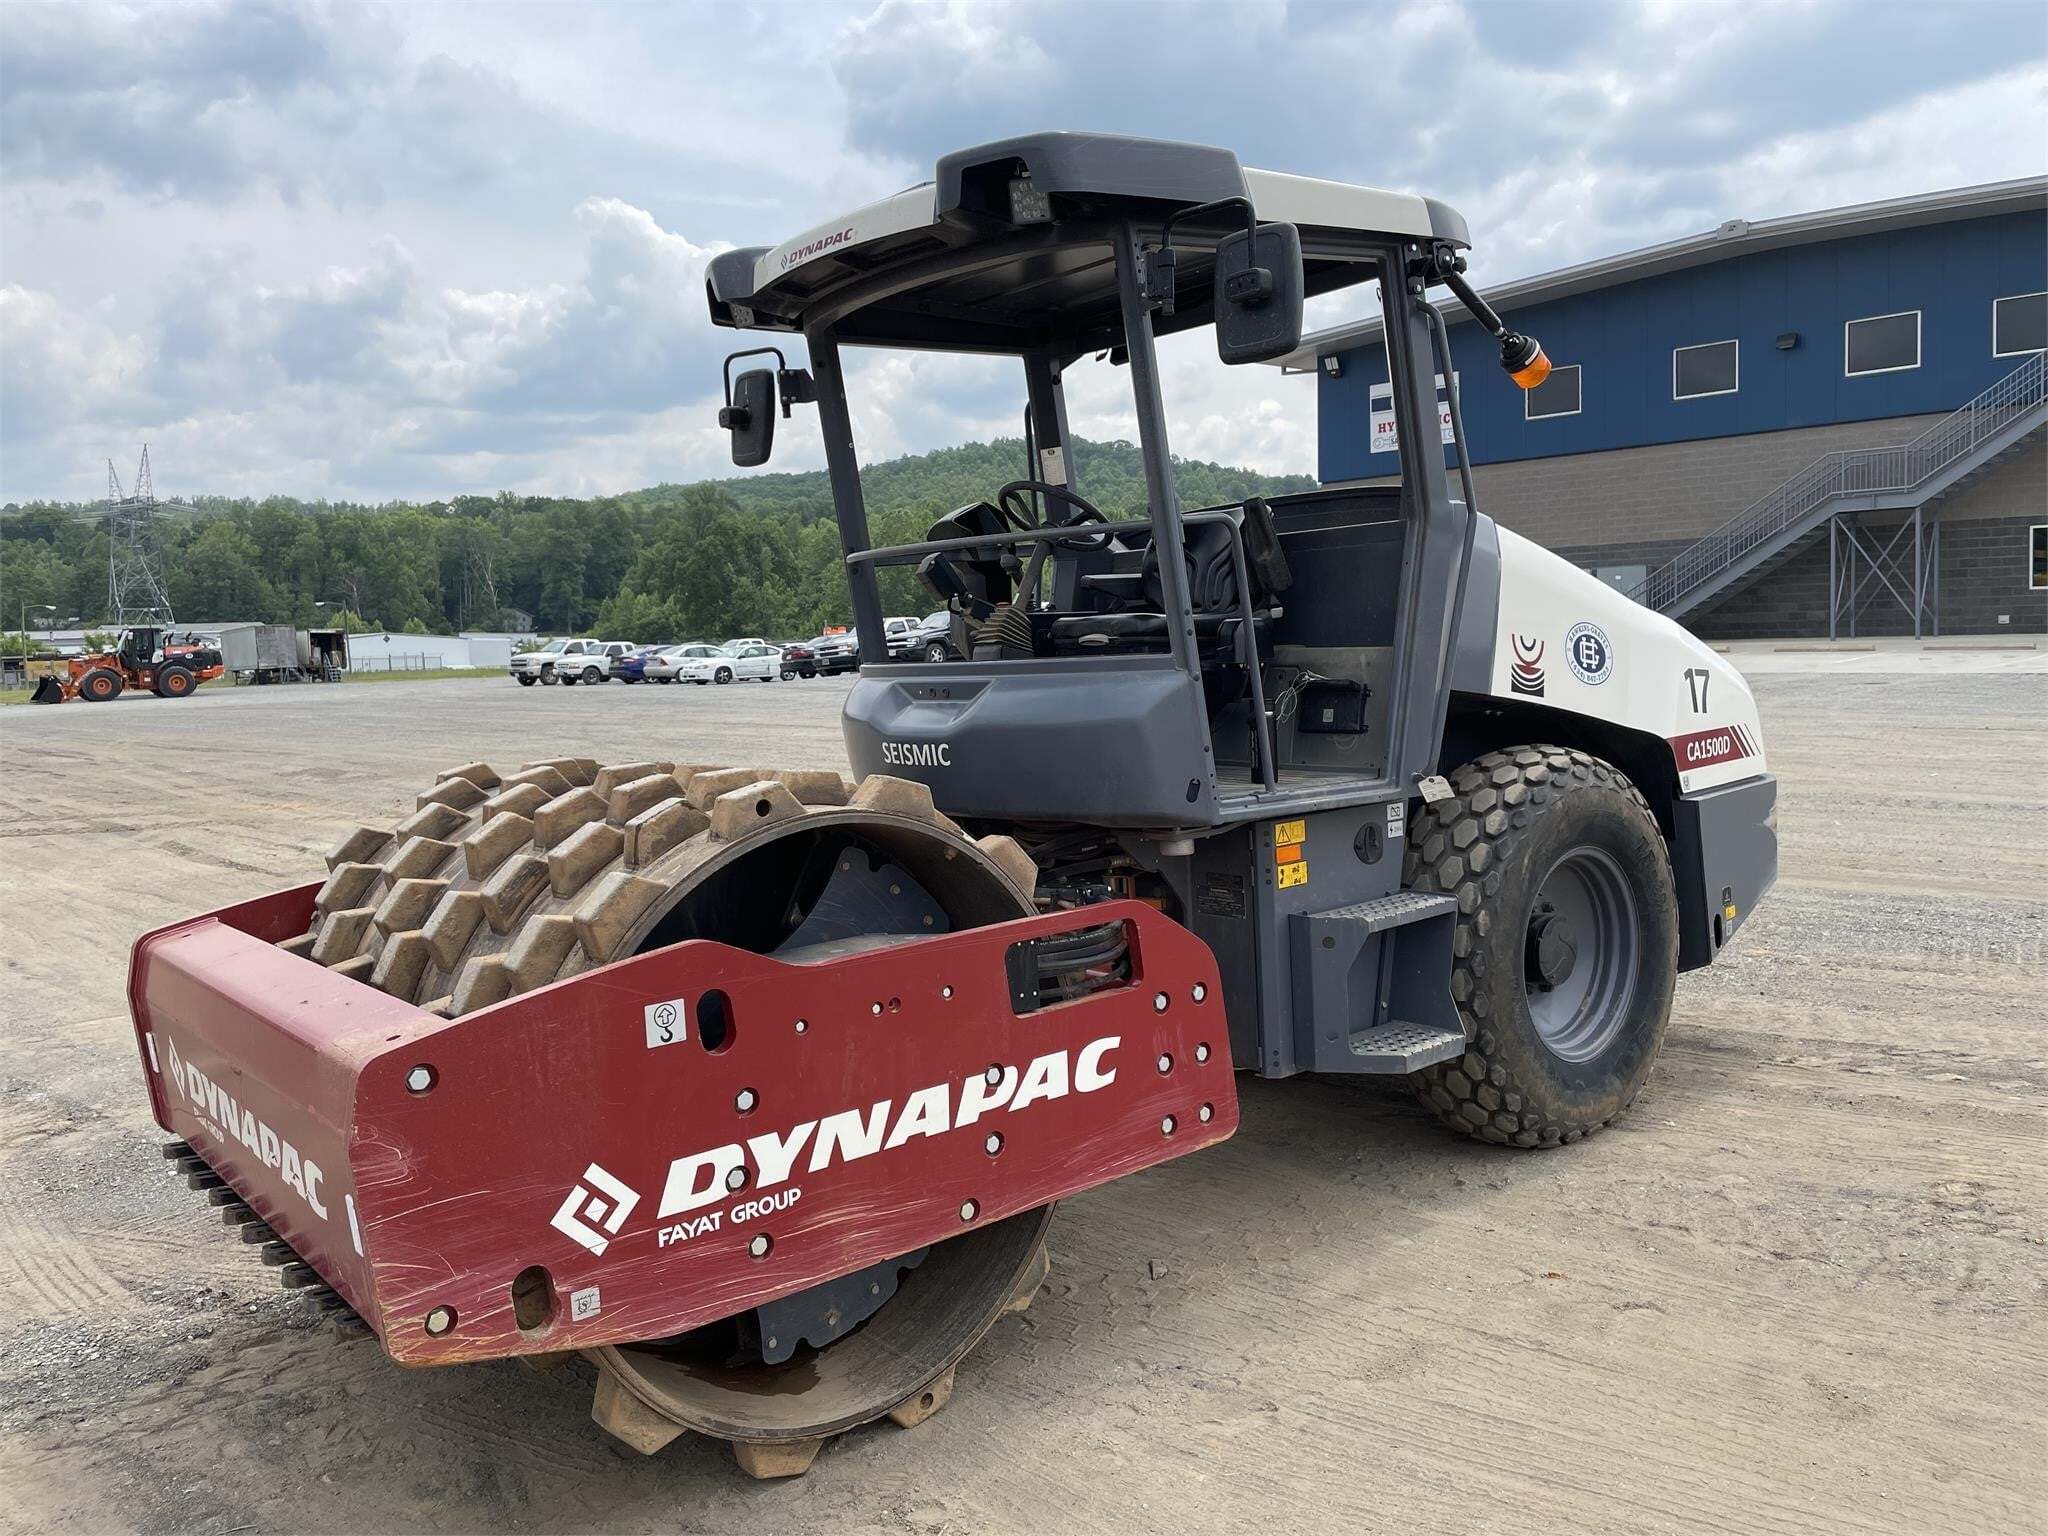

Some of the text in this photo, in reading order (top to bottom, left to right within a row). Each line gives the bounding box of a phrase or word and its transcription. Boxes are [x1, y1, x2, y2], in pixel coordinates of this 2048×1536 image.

[789, 228, 854, 263] DYNAPAC
[1684, 668, 1710, 714] 17
[881, 742, 951, 767] SEISMIC
[1687, 736, 1731, 762] CA1500D
[186, 1060, 329, 1221] DYNAPAC
[656, 1036, 1121, 1219] DYNAPAC
[657, 1187, 802, 1248] FAYAT GROUP
